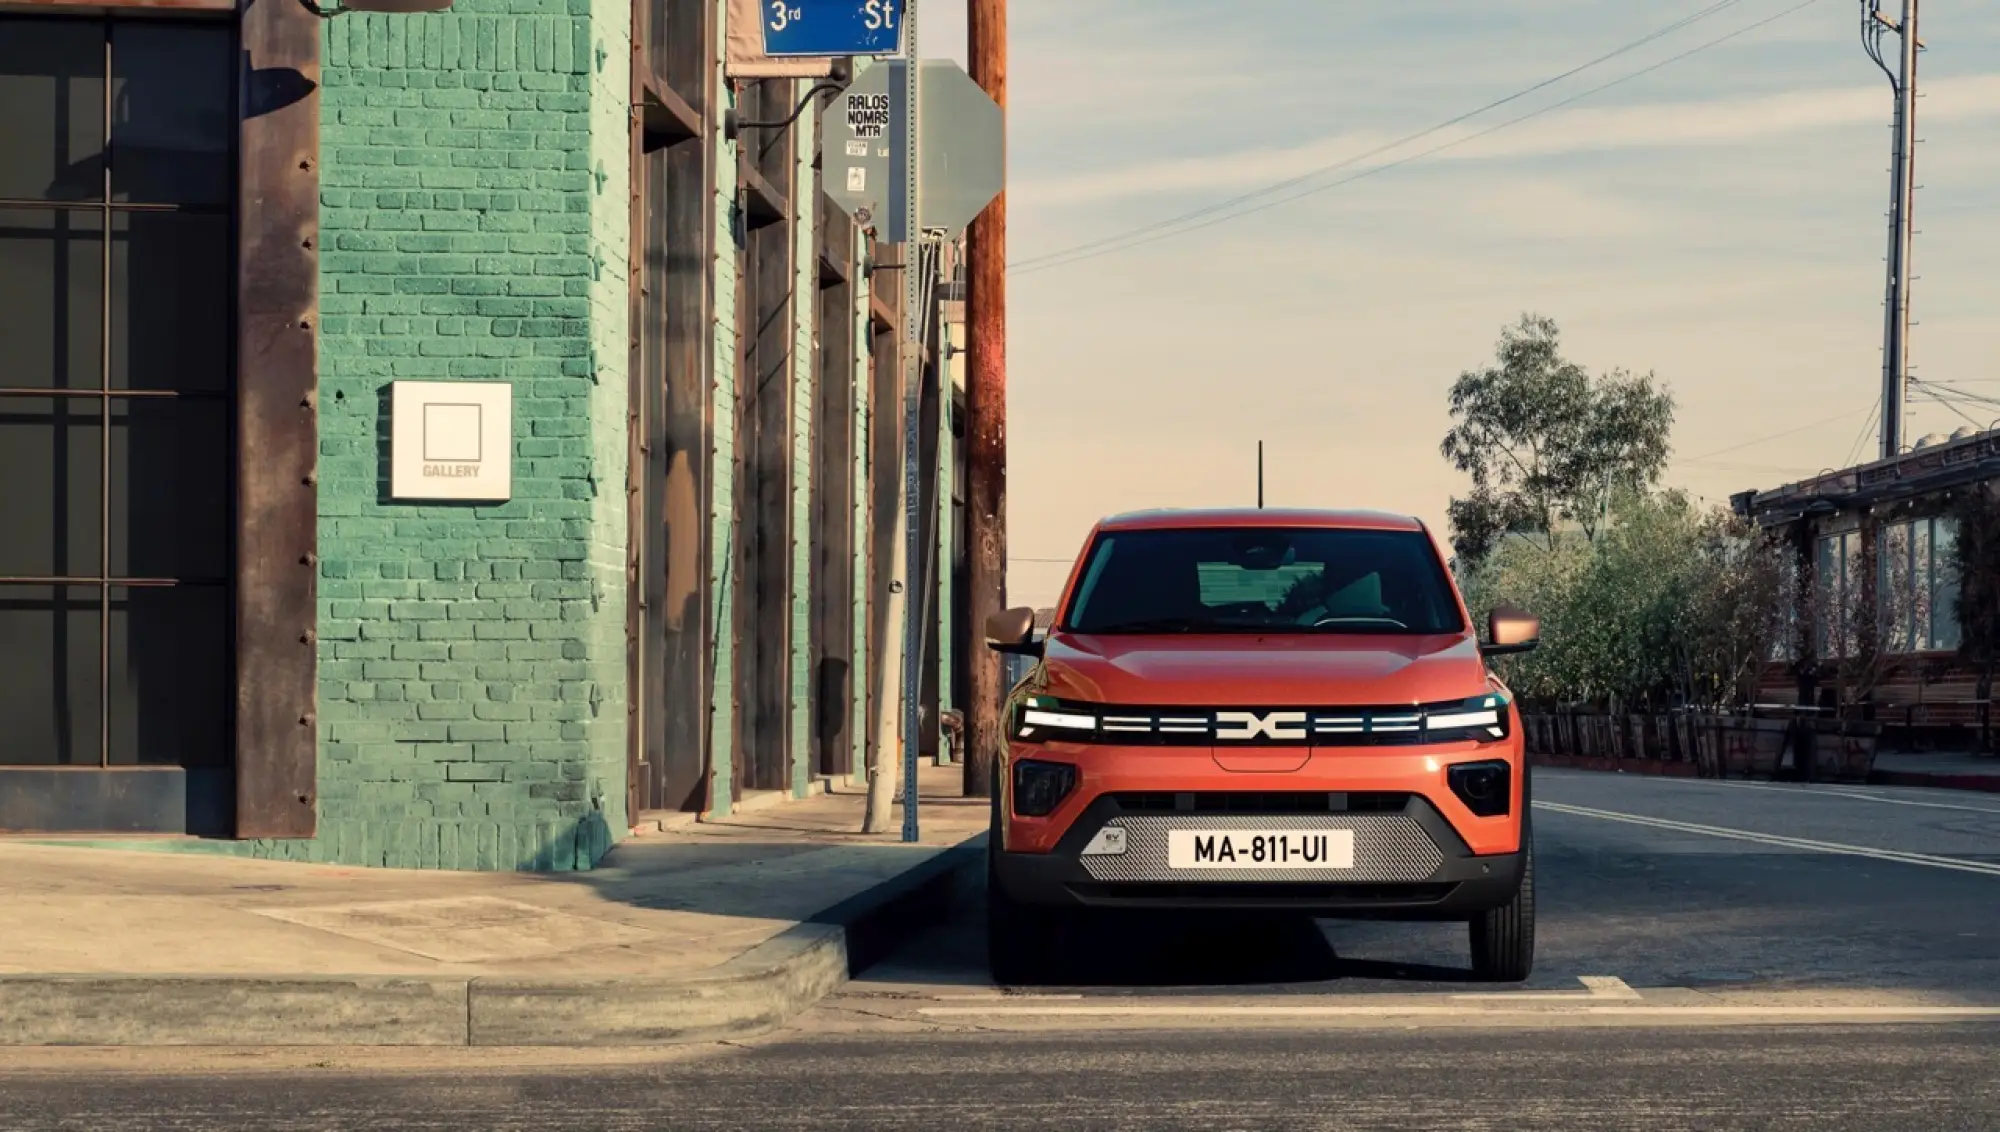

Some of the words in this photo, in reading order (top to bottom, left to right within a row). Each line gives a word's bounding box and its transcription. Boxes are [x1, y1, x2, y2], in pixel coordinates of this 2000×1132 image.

[770, 0, 801, 31] 3rd
[864, 0, 894, 29] St
[848, 95, 889, 110] RALOS
[422, 464, 480, 478] GALLERY
[1194, 835, 1328, 863] MA-811-UI
